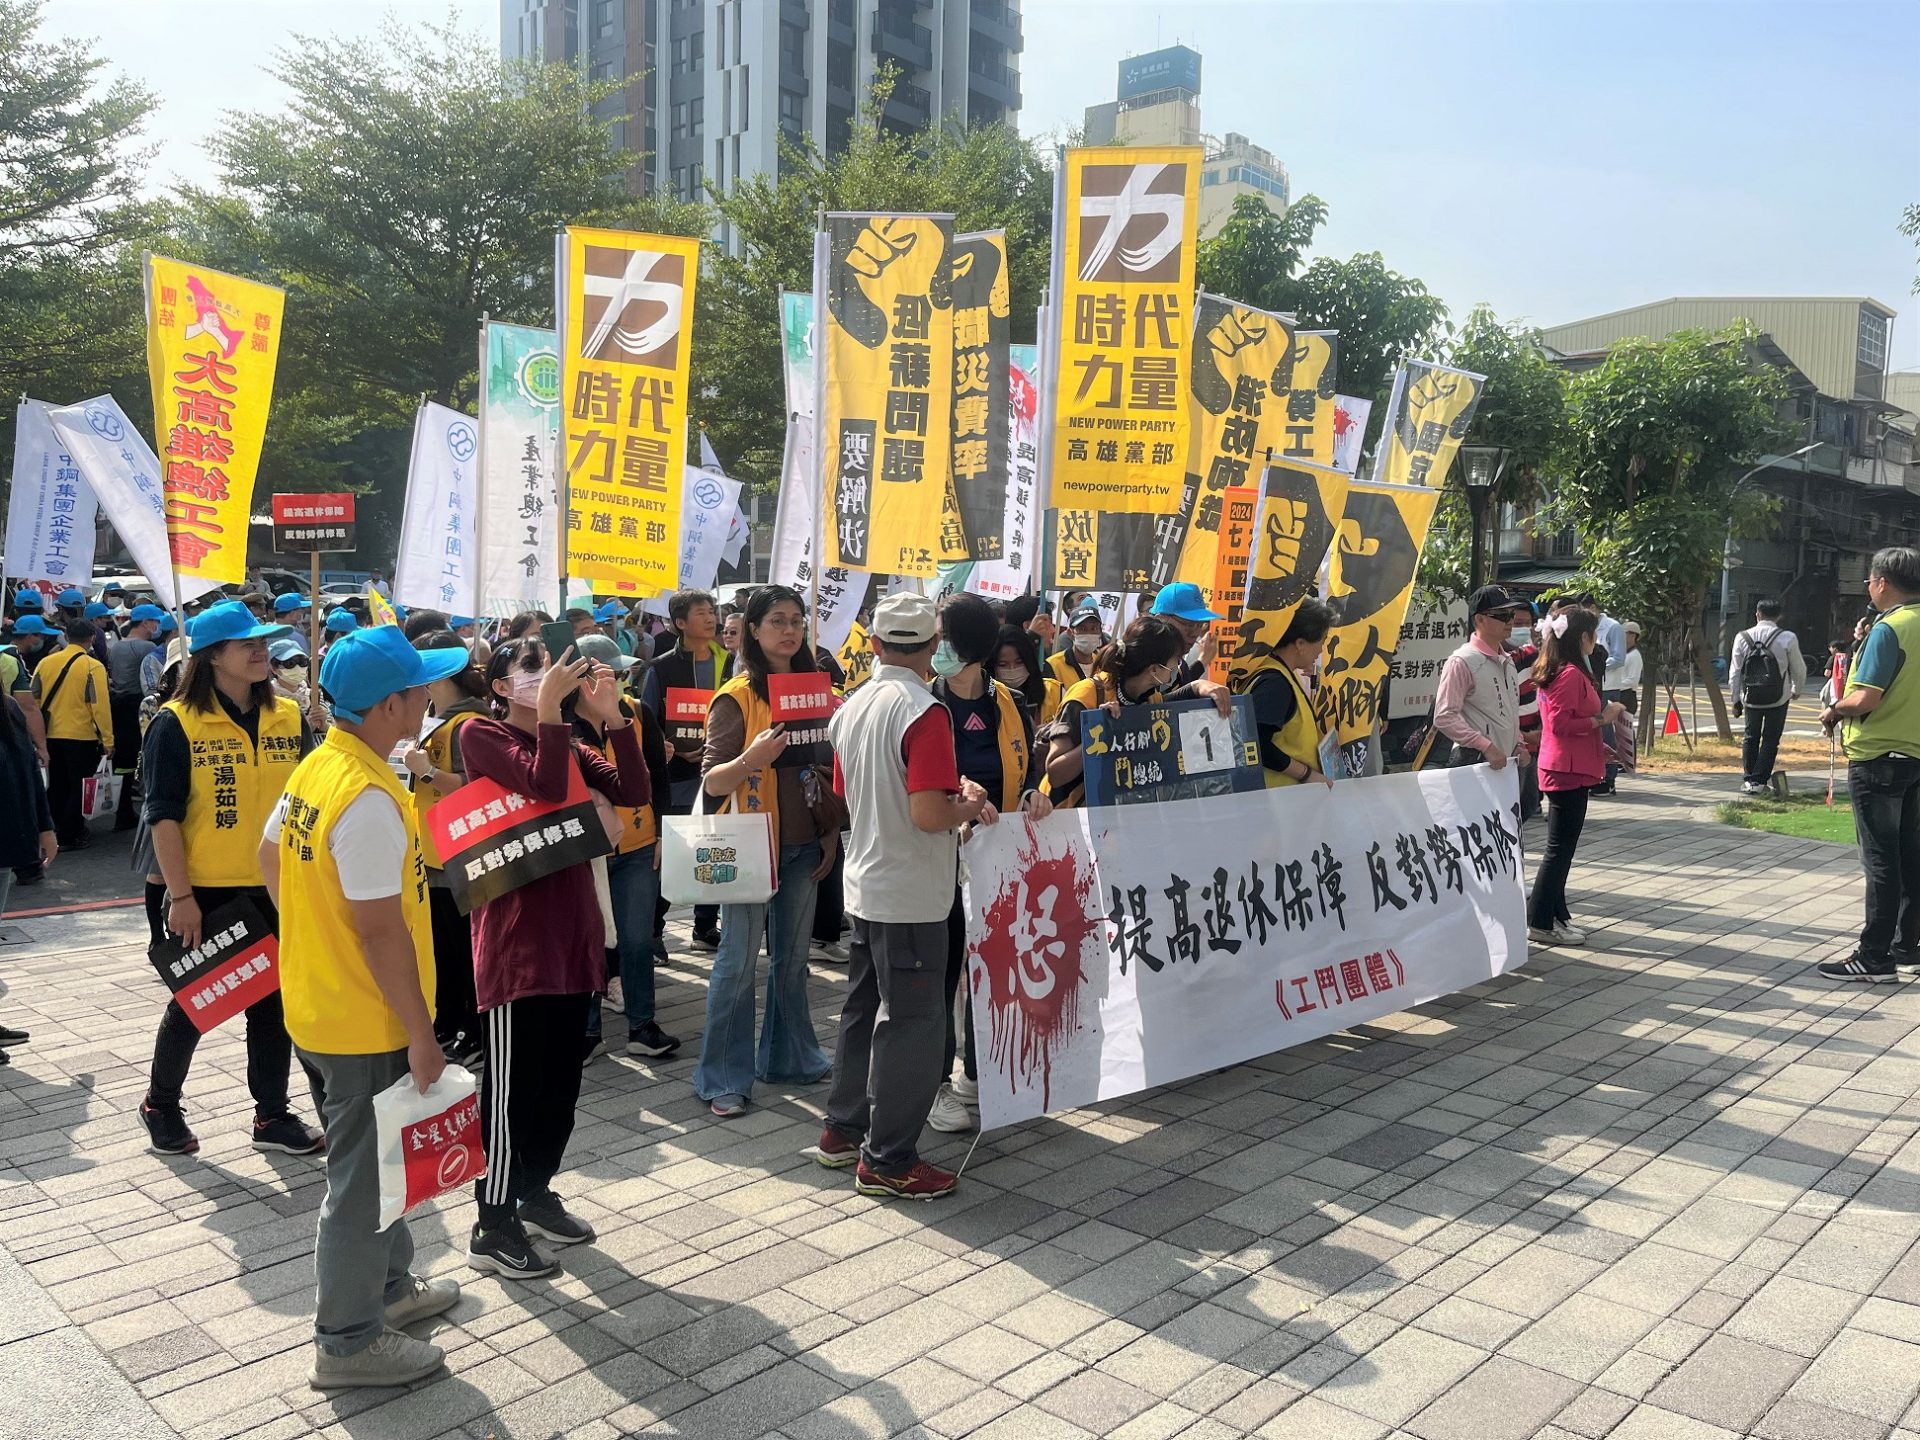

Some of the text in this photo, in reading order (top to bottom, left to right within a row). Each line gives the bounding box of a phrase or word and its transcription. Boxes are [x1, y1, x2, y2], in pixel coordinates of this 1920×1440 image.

[1074, 294, 1179, 349] 時代
[573, 371, 673, 434] 時代
[1074, 354, 1178, 411] 力量
[1068, 438, 1174, 465] 高雄黨部
[1069, 416, 1176, 432] NEW POWER PARTY
[569, 430, 669, 493] 力量
[1063, 480, 1170, 495] newpowerparty.tw
[44, 454, 80, 576] 中鋼集團企業工會
[592, 490, 629, 505] POWER
[632, 497, 666, 512] PARTY
[1231, 504, 1252, 520] 2024
[780, 693, 828, 710] 提高退休保障
[193, 753, 247, 767] 決策委員
[1200, 726, 1213, 762] 1
[213, 766, 238, 829] 湯茹婷
[464, 817, 585, 881] 反對勞保修惡
[1109, 843, 1346, 976] 提高退休保障
[1009, 880, 1066, 999] 怒
